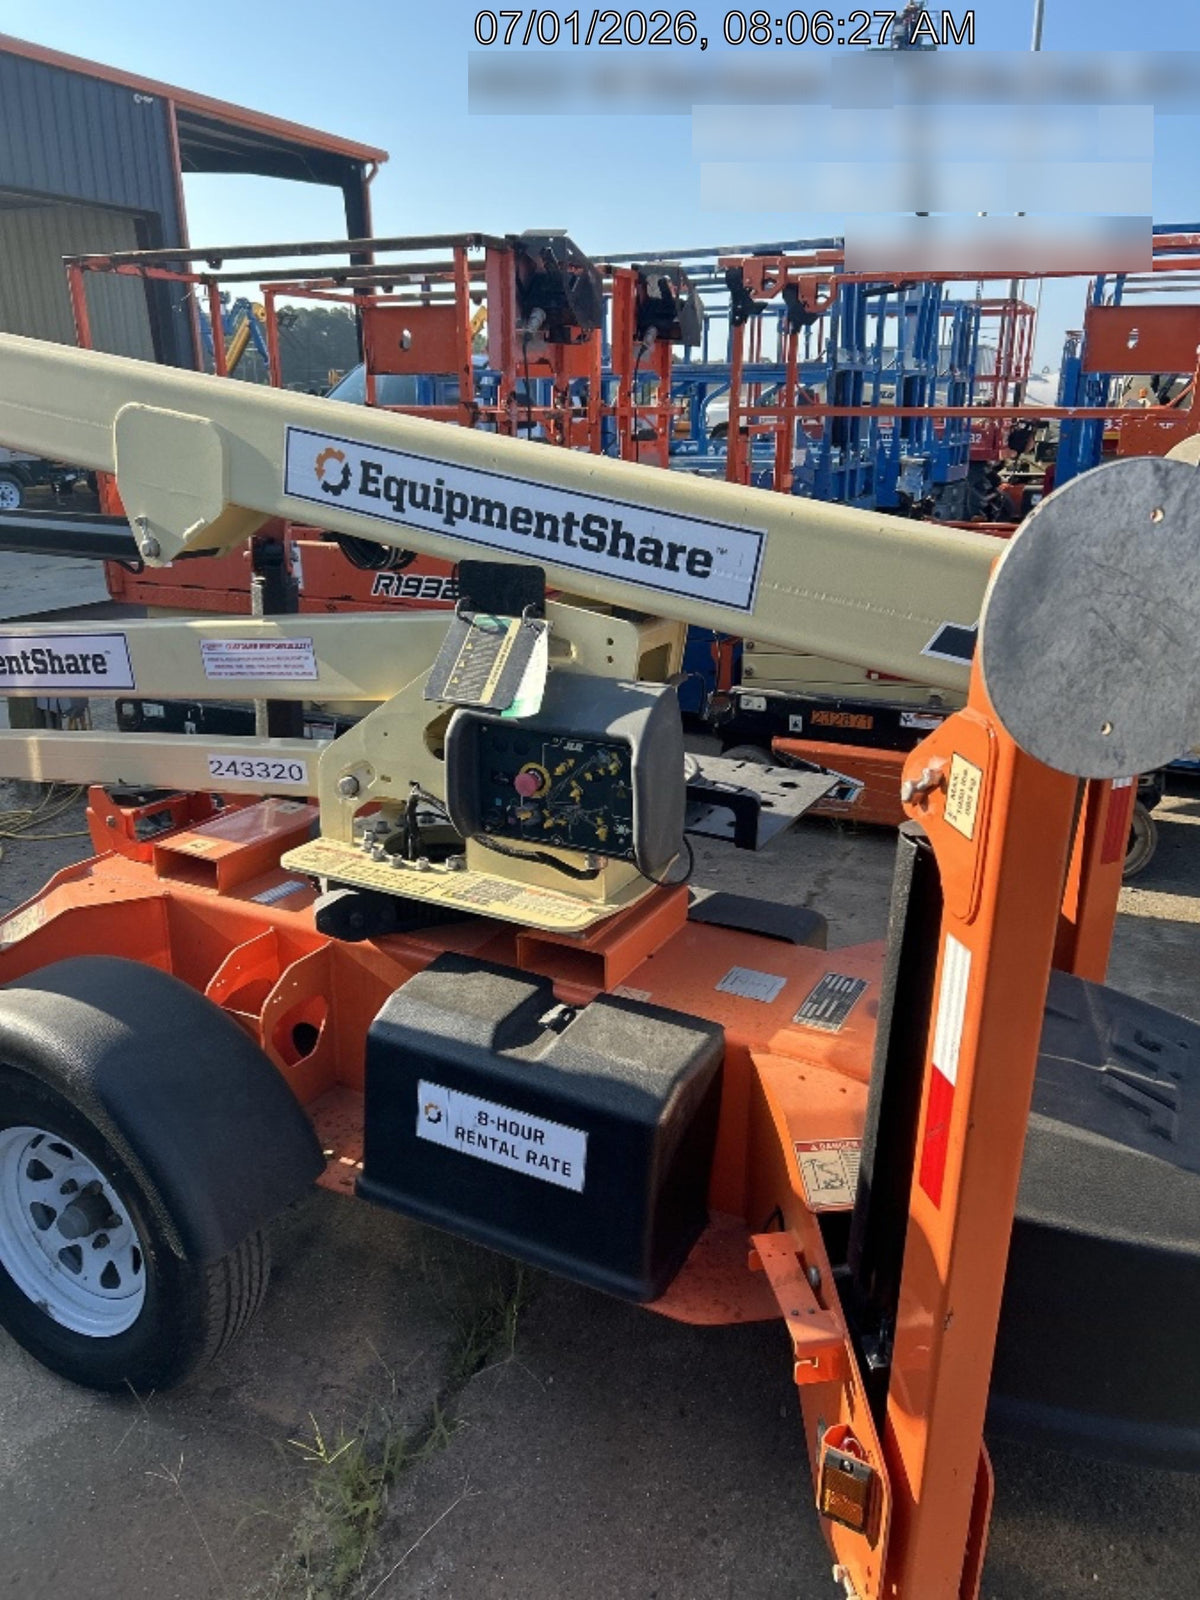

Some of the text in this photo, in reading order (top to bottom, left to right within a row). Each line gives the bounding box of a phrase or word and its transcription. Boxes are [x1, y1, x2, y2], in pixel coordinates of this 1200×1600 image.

[358, 459, 714, 579] EquipmentShare
[209, 759, 304, 782] 243320
[476, 1110, 545, 1146] 8-HOUR
[454, 1126, 572, 1178] RENTAL RATE
